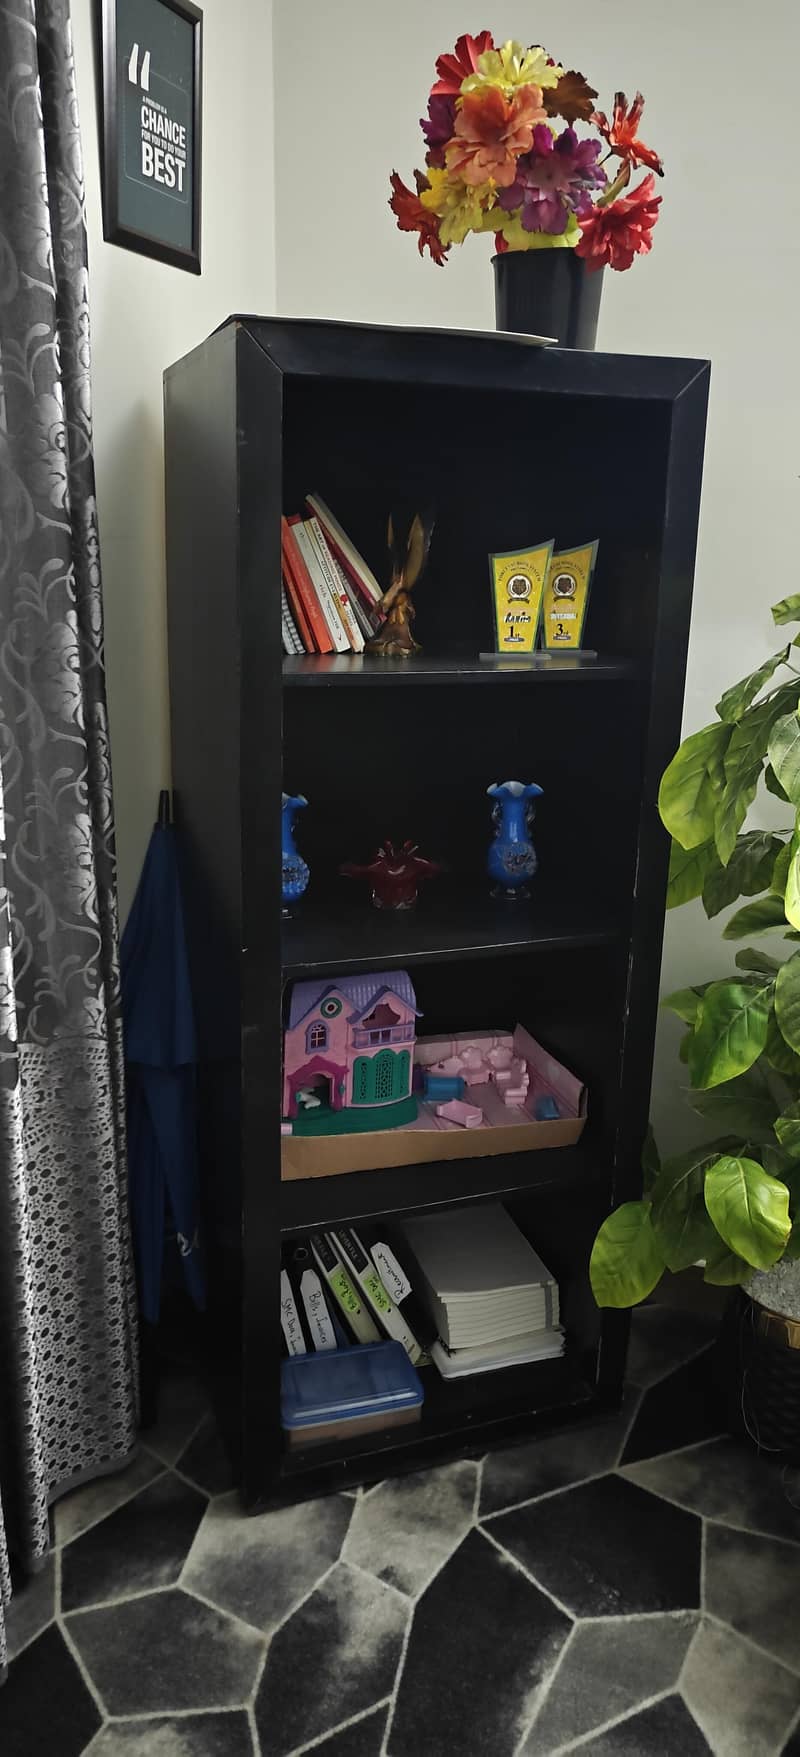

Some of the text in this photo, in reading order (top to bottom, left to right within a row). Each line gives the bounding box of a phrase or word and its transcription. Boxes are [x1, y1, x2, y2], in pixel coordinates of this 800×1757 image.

[141, 105, 186, 148] CHANCE
[142, 128, 151, 142] FOR
[151, 132, 161, 147] YOU
[161, 138, 168, 151] TO
[168, 143, 175, 154] DO
[142, 141, 186, 192] BEST
